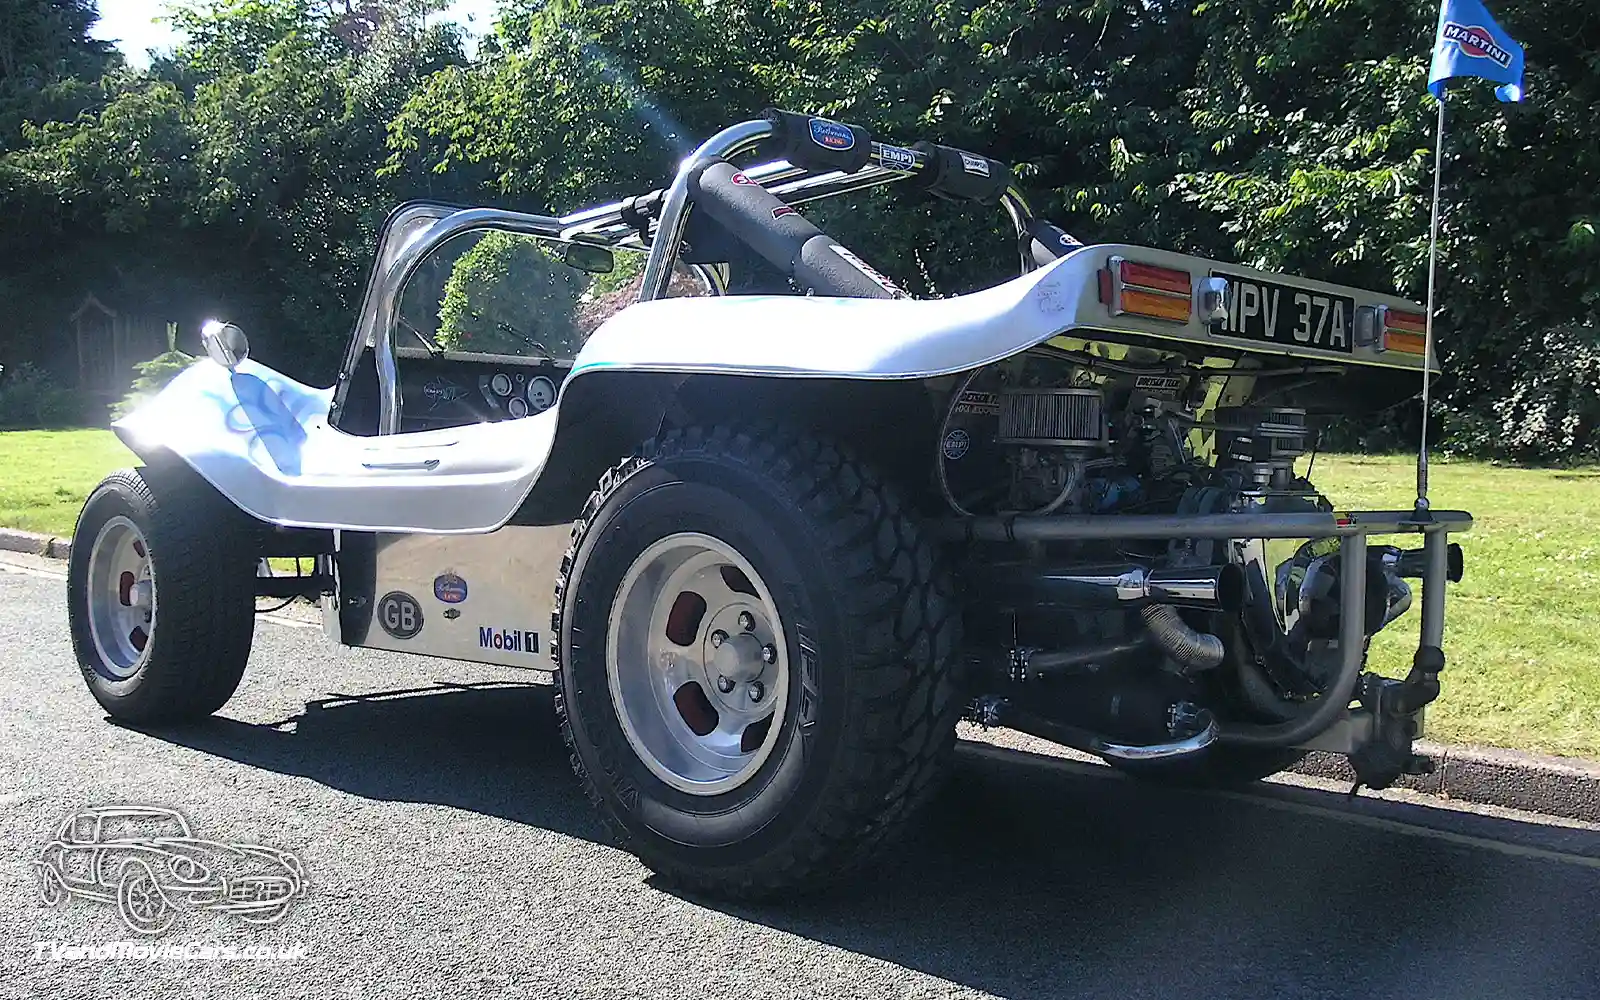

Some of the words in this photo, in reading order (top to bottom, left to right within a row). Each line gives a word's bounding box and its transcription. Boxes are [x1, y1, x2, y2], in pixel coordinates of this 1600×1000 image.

[1445, 26, 1506, 62] MARTINI
[883, 149, 912, 163] EMPI
[1293, 292, 1345, 347] 37A
[384, 600, 415, 631] GB
[479, 626, 522, 652] Mobil
[527, 632, 536, 652] 1
